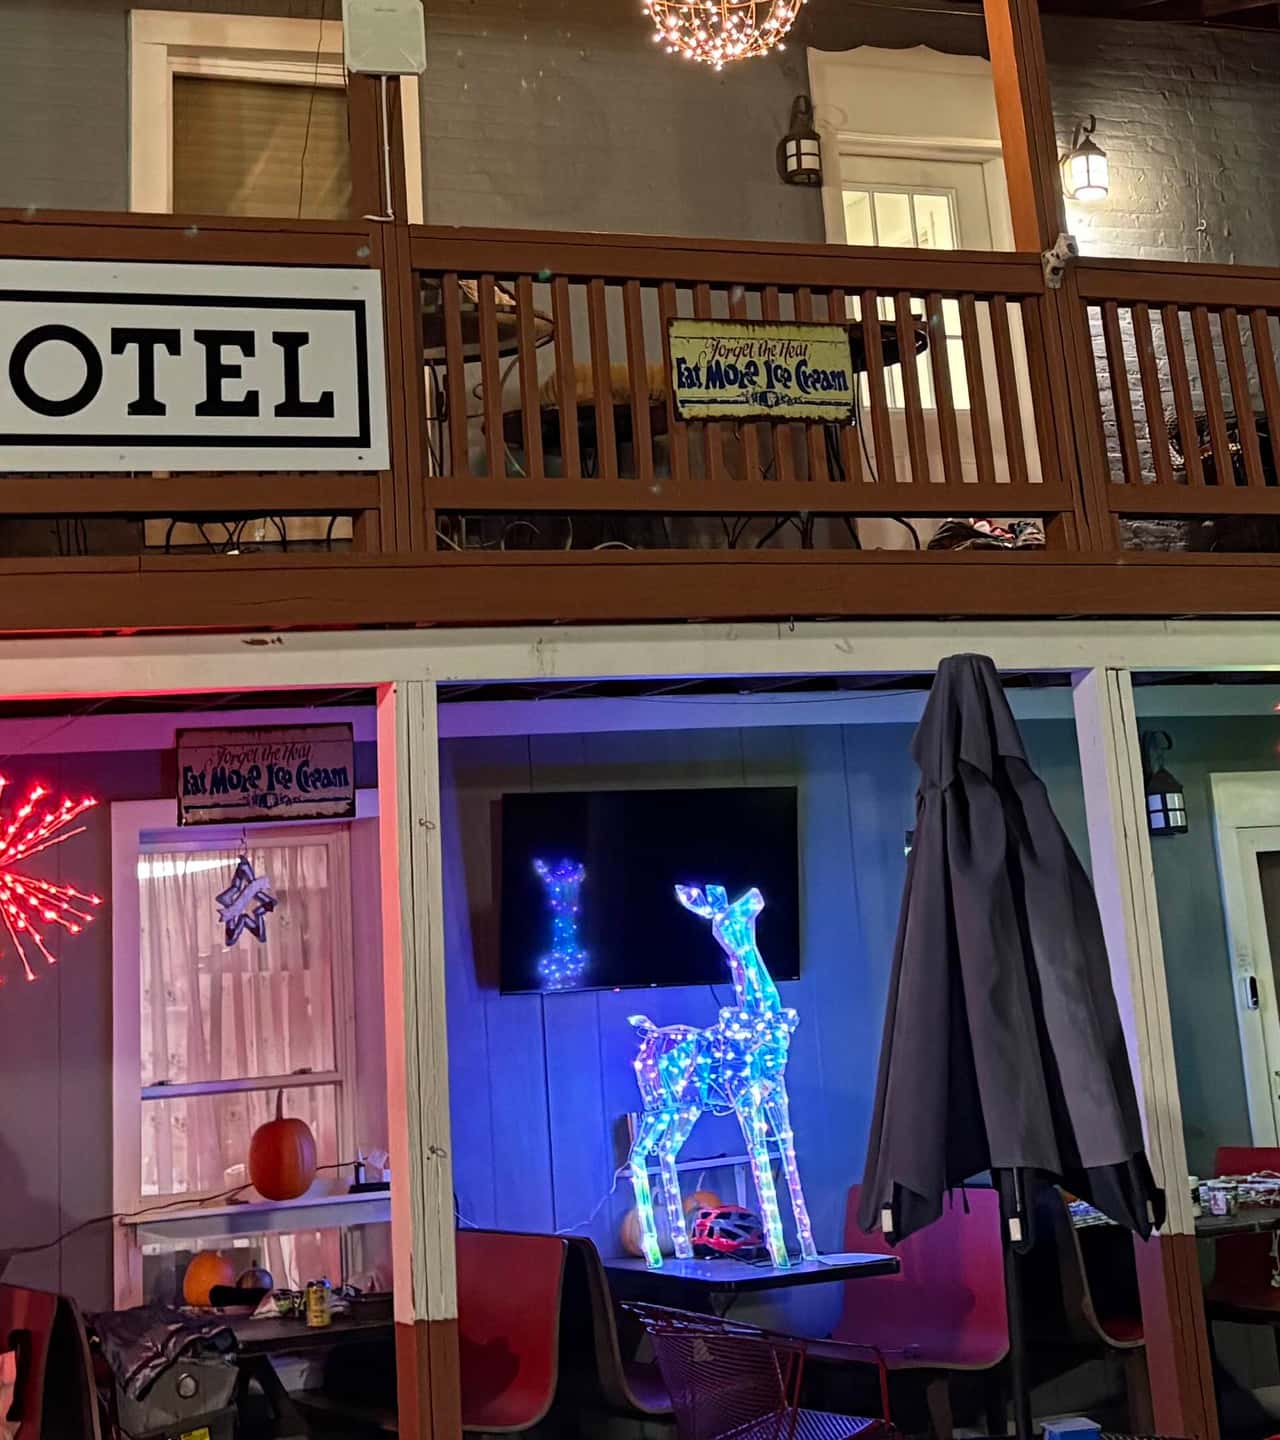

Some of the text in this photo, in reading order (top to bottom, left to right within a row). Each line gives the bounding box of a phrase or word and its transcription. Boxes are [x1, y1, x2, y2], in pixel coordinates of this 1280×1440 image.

[703, 338, 809, 364] Forget the Heat
[676, 357, 849, 394] Eat More Ice Cream
[183, 760, 350, 796] Eat More Ice Cream
